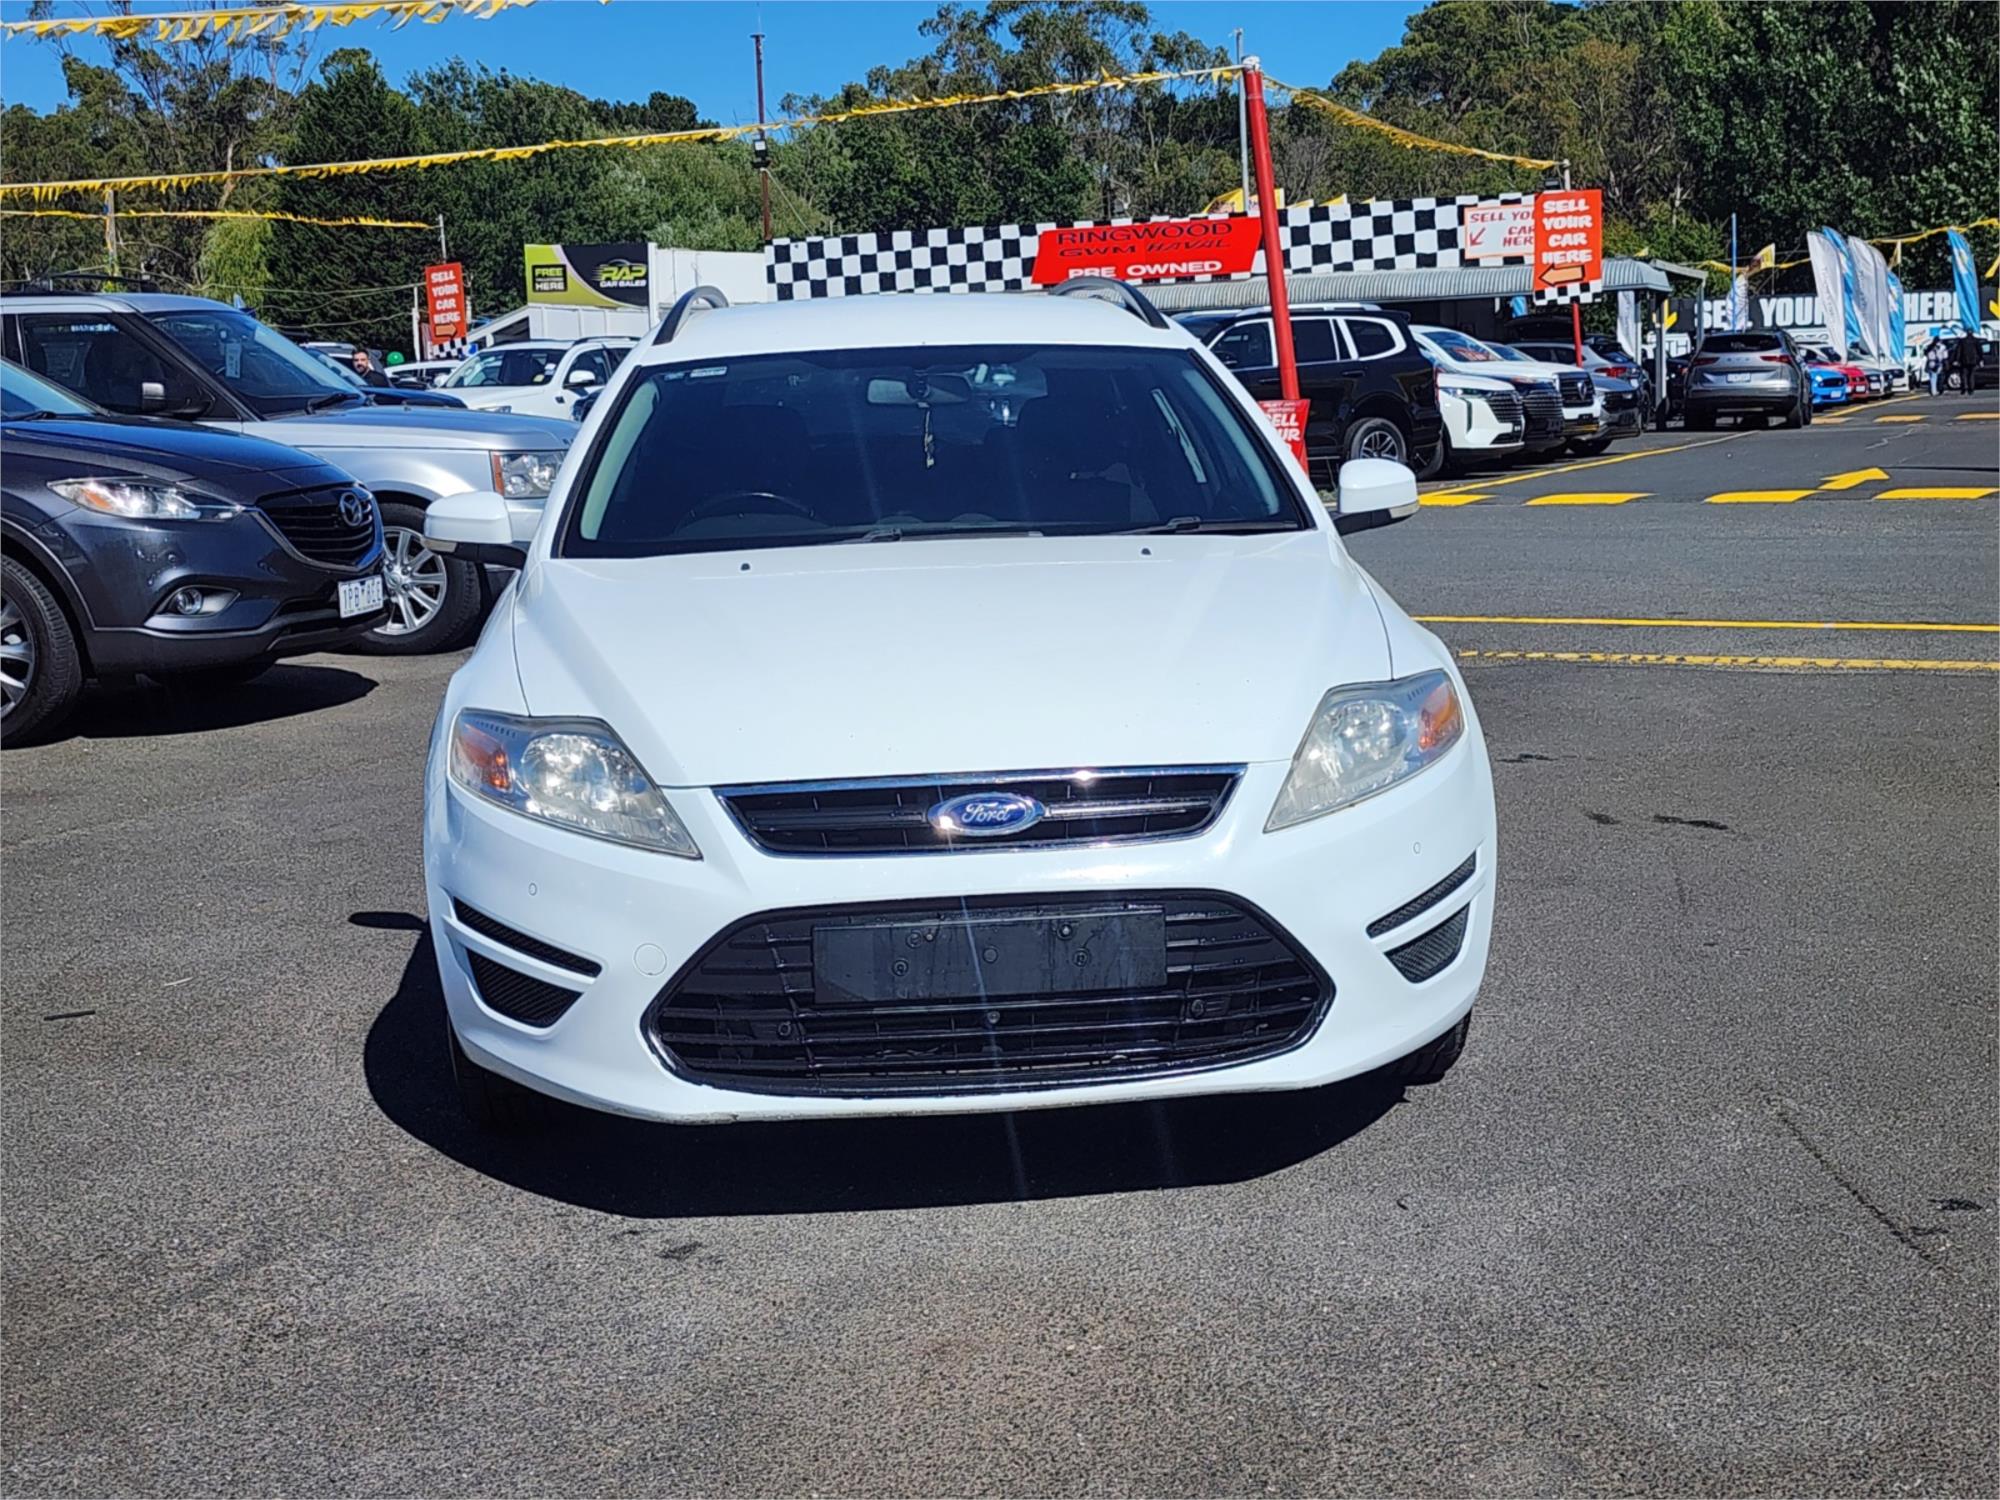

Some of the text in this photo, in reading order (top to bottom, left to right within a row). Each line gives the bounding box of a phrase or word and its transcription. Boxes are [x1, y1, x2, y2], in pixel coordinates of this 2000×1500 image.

[1543, 199, 1589, 213] SELL
[1470, 210, 1534, 223] SELL YO
[1543, 215, 1593, 230] YOUR
[1057, 222, 1232, 244] RINGWOOD
[1548, 233, 1587, 247] CAR
[1059, 244, 1137, 257] GWM
[1542, 250, 1592, 264] HERE
[535, 267, 564, 277] FREE
[1068, 259, 1223, 278] PRE OWNED
[431, 270, 456, 283] SELL
[432, 284, 459, 297] YOUR
[535, 281, 564, 291] HERE
[600, 280, 646, 288] CAR SALES
[436, 298, 456, 310] CAR
[961, 801, 1013, 823] Ford
